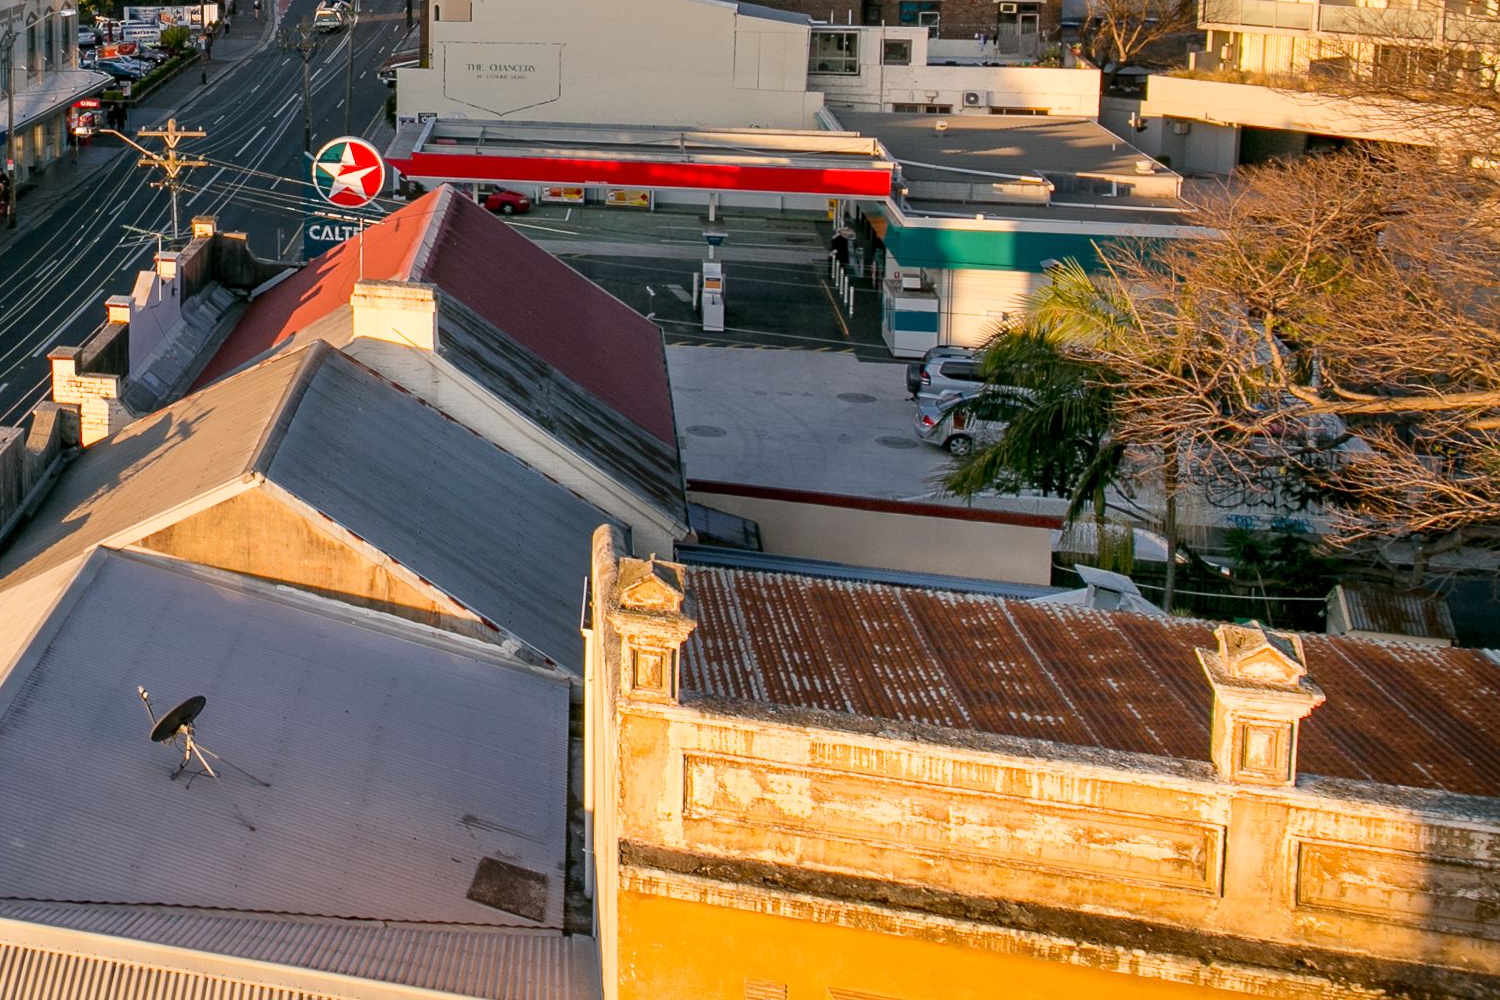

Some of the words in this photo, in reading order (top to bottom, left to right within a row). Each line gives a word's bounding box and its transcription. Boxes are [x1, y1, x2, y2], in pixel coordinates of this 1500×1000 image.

[466, 63, 484, 72] THE
[489, 63, 536, 73] CHANCERY
[309, 225, 366, 241] CALTE
